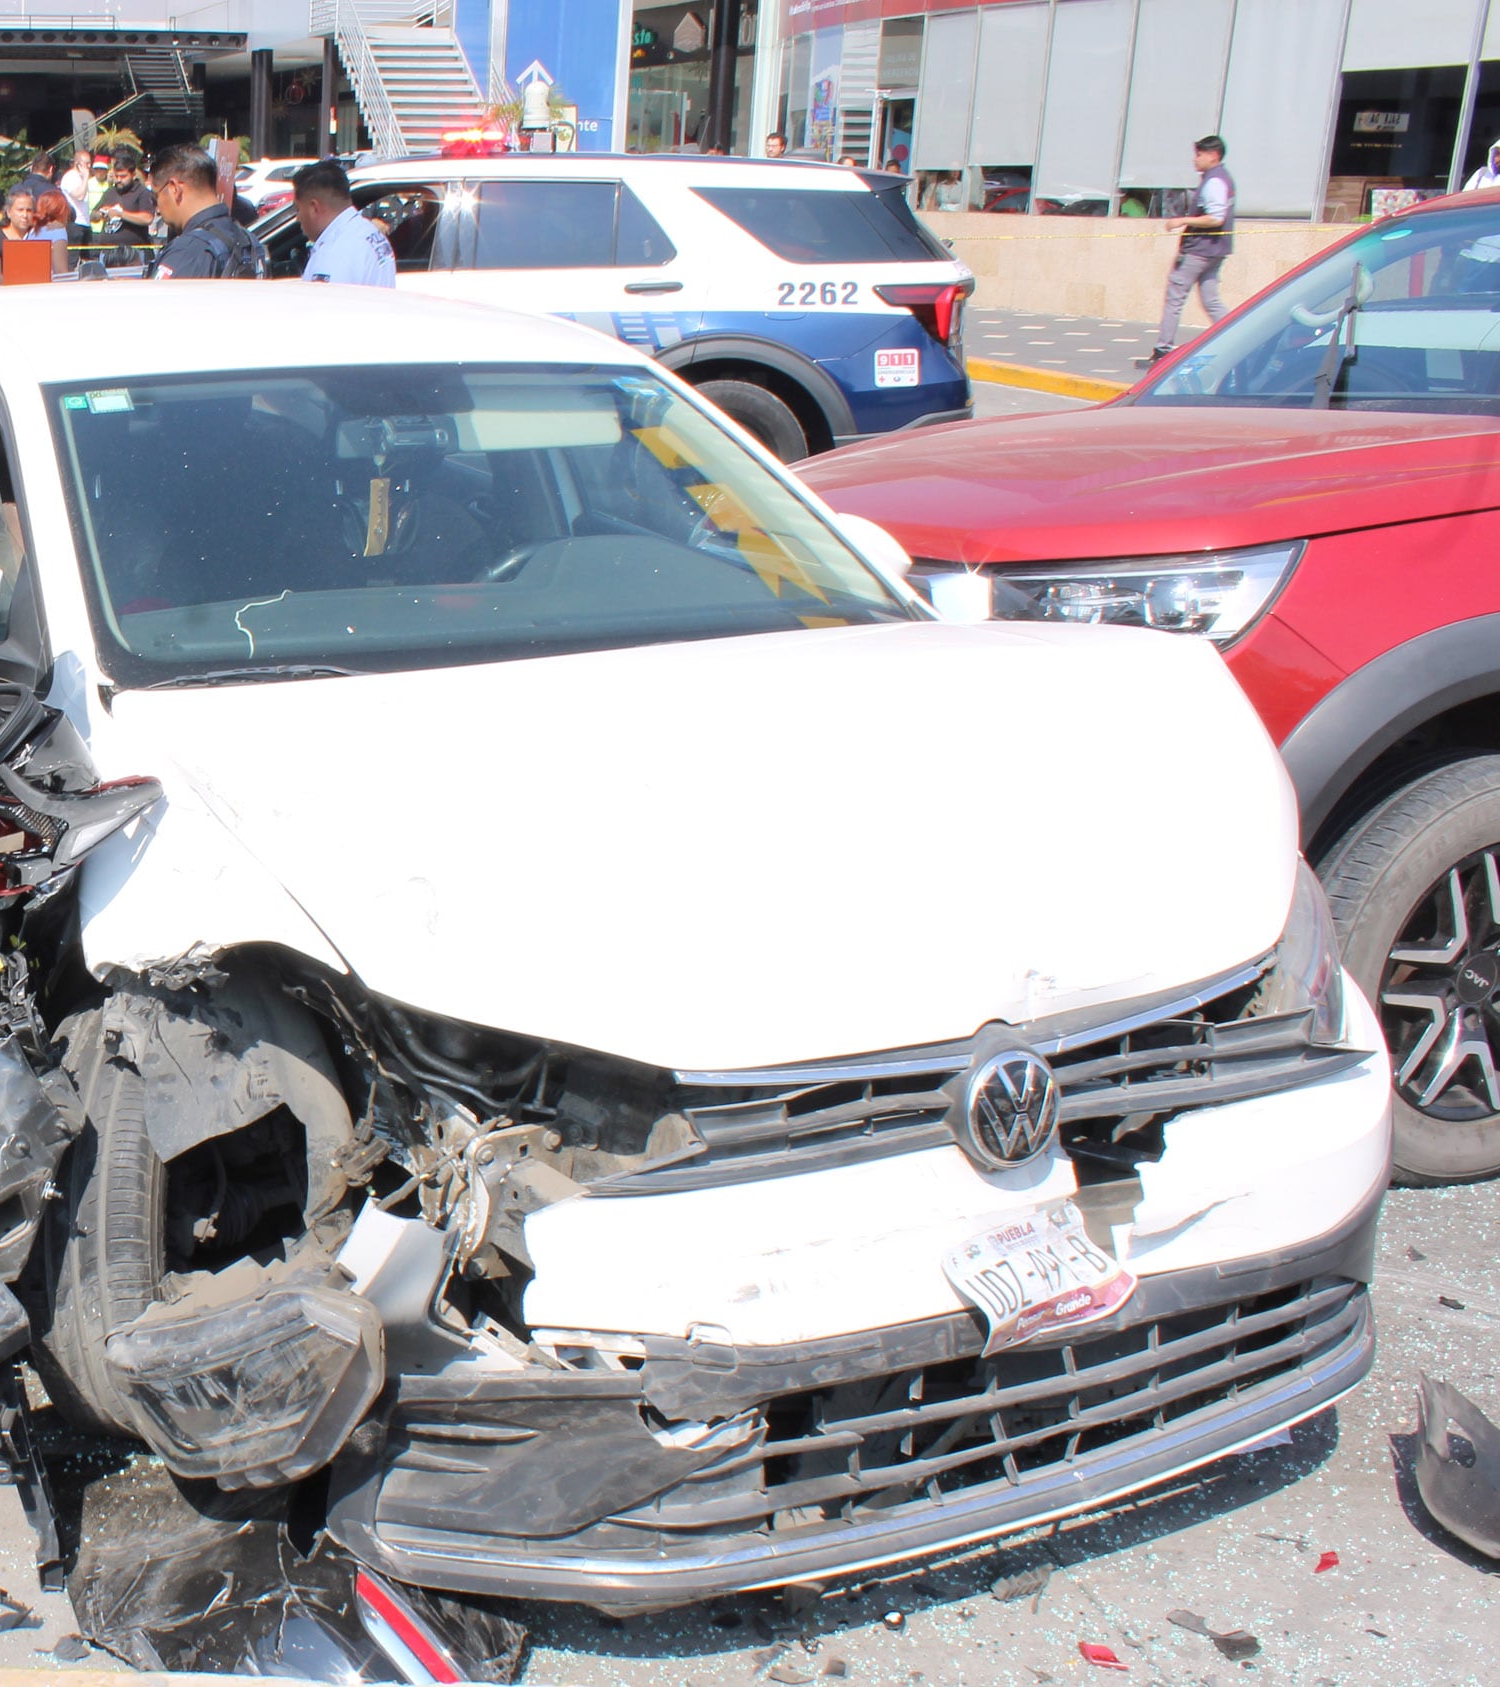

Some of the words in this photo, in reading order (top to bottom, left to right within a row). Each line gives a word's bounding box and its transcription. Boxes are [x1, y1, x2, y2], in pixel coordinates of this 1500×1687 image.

[778, 281, 859, 306] 2262
[878, 353, 916, 367] 911
[1464, 969, 1489, 988] JAC
[996, 1222, 1035, 1246] PUEBLA
[1054, 1291, 1092, 1316] Grande
